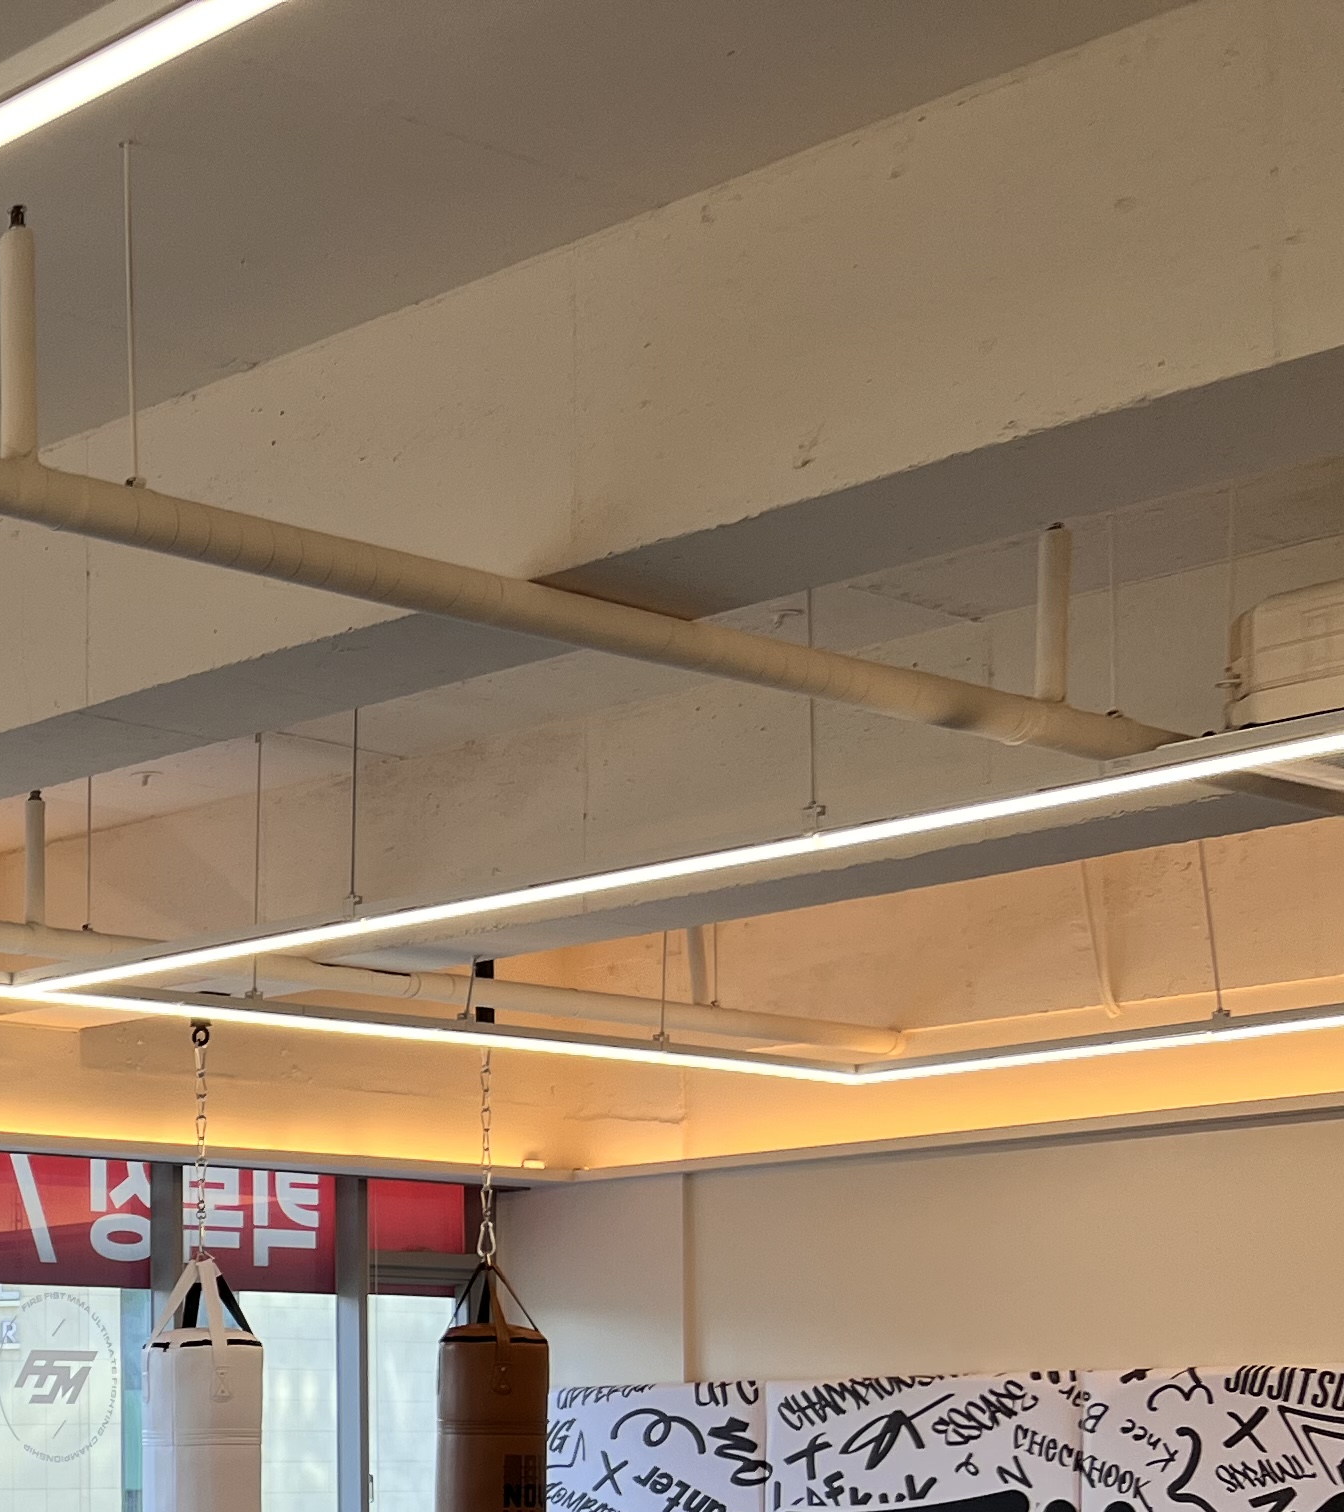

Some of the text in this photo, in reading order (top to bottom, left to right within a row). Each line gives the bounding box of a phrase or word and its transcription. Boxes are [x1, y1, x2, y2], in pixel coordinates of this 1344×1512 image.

[21, 1292, 118, 1463] FIRE FIST MMA ULTIMATE FIGHTING CHAMPIONSHIP
[1215, 1454, 1317, 1493] SPRAWL
